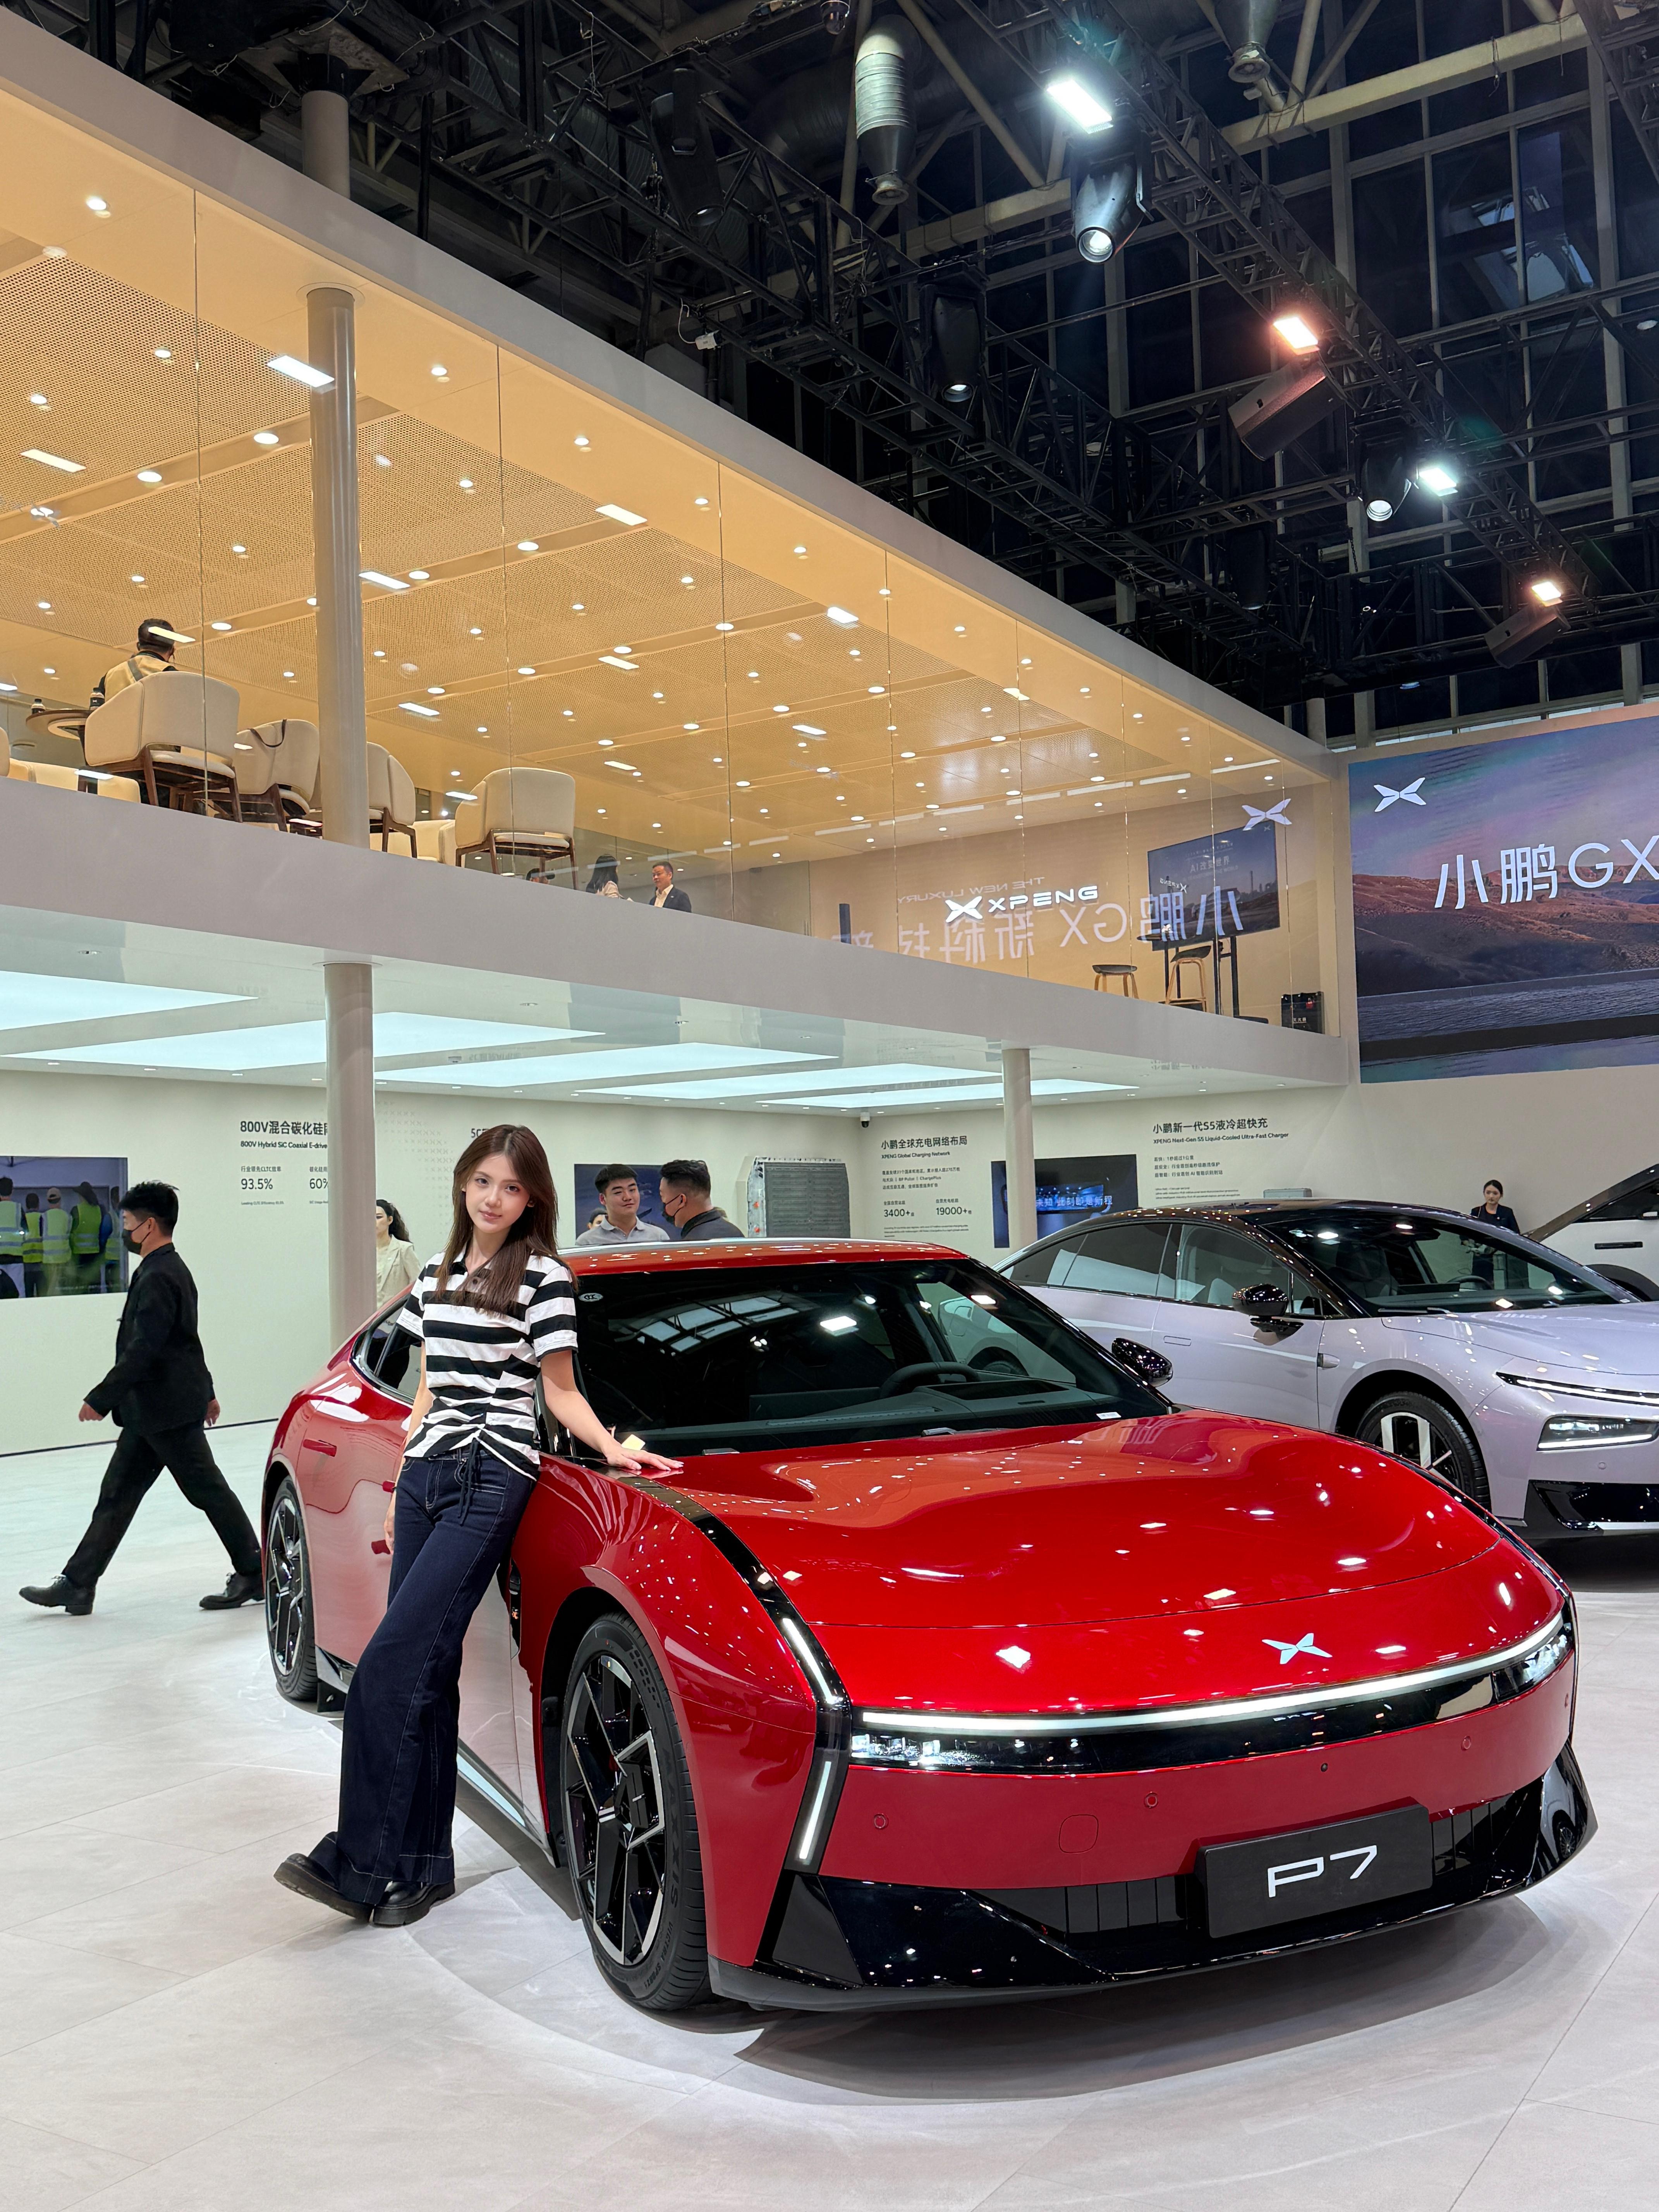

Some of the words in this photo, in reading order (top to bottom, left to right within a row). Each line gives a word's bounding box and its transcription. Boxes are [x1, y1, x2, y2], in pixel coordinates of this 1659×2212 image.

[1434, 835, 1659, 910] 小鹏GX
[988, 885, 1098, 913] XPENG
[1153, 1118, 1268, 1134] 小鹏新一代S5液冷超快充
[881, 1135, 967, 1150] 小鹏全球充电网络布局
[241, 1178, 273, 1190] 93.5%
[1267, 1845, 1377, 1898] P7
